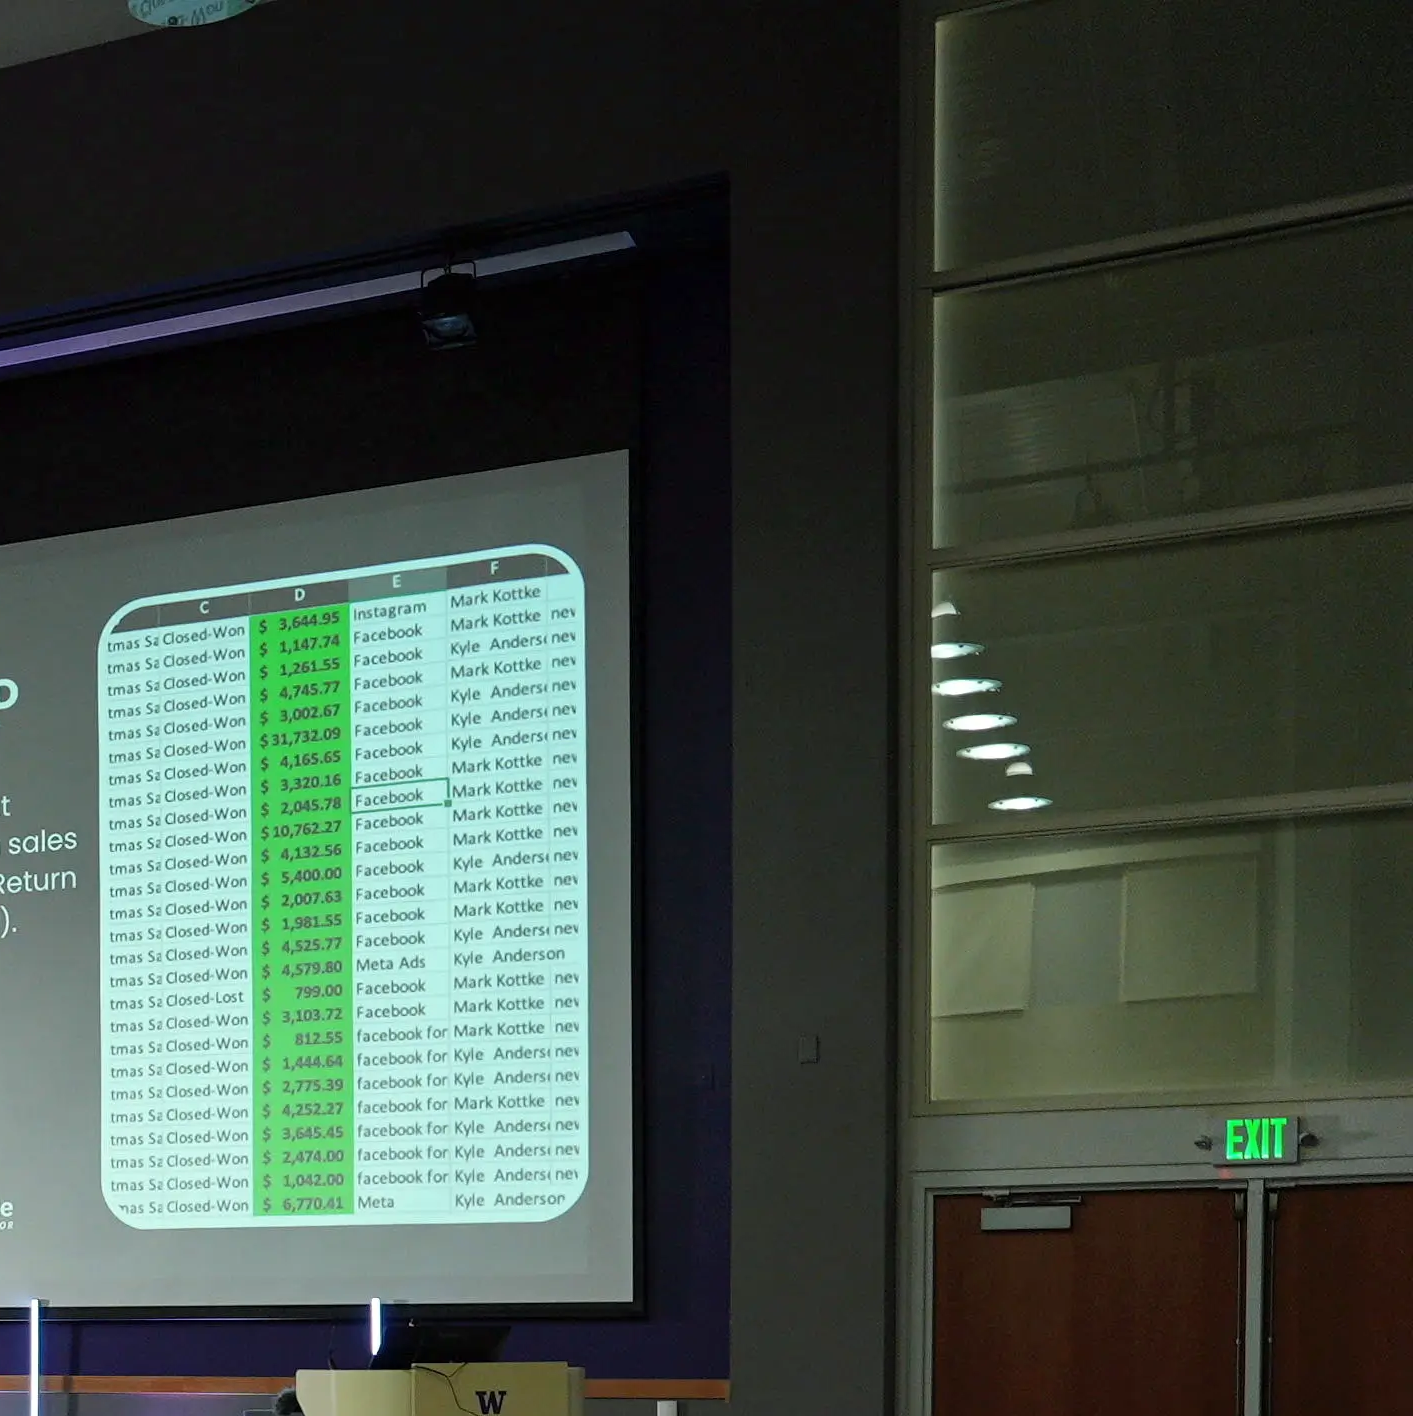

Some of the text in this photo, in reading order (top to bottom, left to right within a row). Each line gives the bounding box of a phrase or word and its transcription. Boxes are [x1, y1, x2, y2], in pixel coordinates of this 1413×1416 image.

[200, 561, 499, 614] C D E F
[162, 585, 541, 645] Closed-Won 3,644.95 Instagram Mark Kottke
[163, 608, 541, 668] Closed-Won 1,147.74 Facebook Mark Kottke
[163, 670, 246, 690] Closed-Won
[279, 657, 340, 678] 1,261.55
[354, 647, 423, 668] Facebook
[451, 640, 480, 658] Kyle
[163, 657, 541, 712] Closed-Won 4,745.77 Facebook Mark Kottke
[163, 716, 246, 735] Closed-Won
[280, 703, 341, 724] 3,002.67
[354, 694, 423, 713] Facebook
[451, 688, 481, 706] Kyle
[163, 739, 246, 757] Closed-Won
[272, 726, 341, 748] 31,732.09
[355, 717, 423, 737] Facebook
[451, 711, 481, 729] Kyle
[164, 761, 247, 780] Closed-Won
[280, 750, 341, 770] 4,165.65
[355, 740, 423, 761] Facebook
[452, 735, 482, 752] Kyle
[164, 753, 542, 802] Closed-Won 3,320.16 Facebook Mark Kottke
[164, 777, 543, 825] Closed-Won 2,045.78 Facebook Mark Kottke
[8, 829, 77, 855] sales
[165, 801, 543, 848] Closed-Won 10,762.27 Facebook Mark Kottke
[164, 826, 543, 870] Closed-Won 4,132.56 Facebook Mark Kottke
[164, 875, 247, 893] Closed-Won
[281, 866, 342, 886] 5,400.00
[356, 859, 424, 878] Facebook
[453, 855, 484, 872] Kyle
[165, 873, 543, 916] Closed-Won 2,007.63 Facebook Mark Kottke
[282, 913, 342, 933] 1,981.55
[281, 948, 565, 978] 4,579.80 Meta Ads Kyle Anderson
[282, 937, 342, 956] 4,525.77
[166, 984, 343, 1007] Closed-Lost 799.00
[282, 1007, 343, 1025] 3,103.72
[1225, 1117, 1288, 1160] EXIT
[475, 1390, 507, 1415] W
